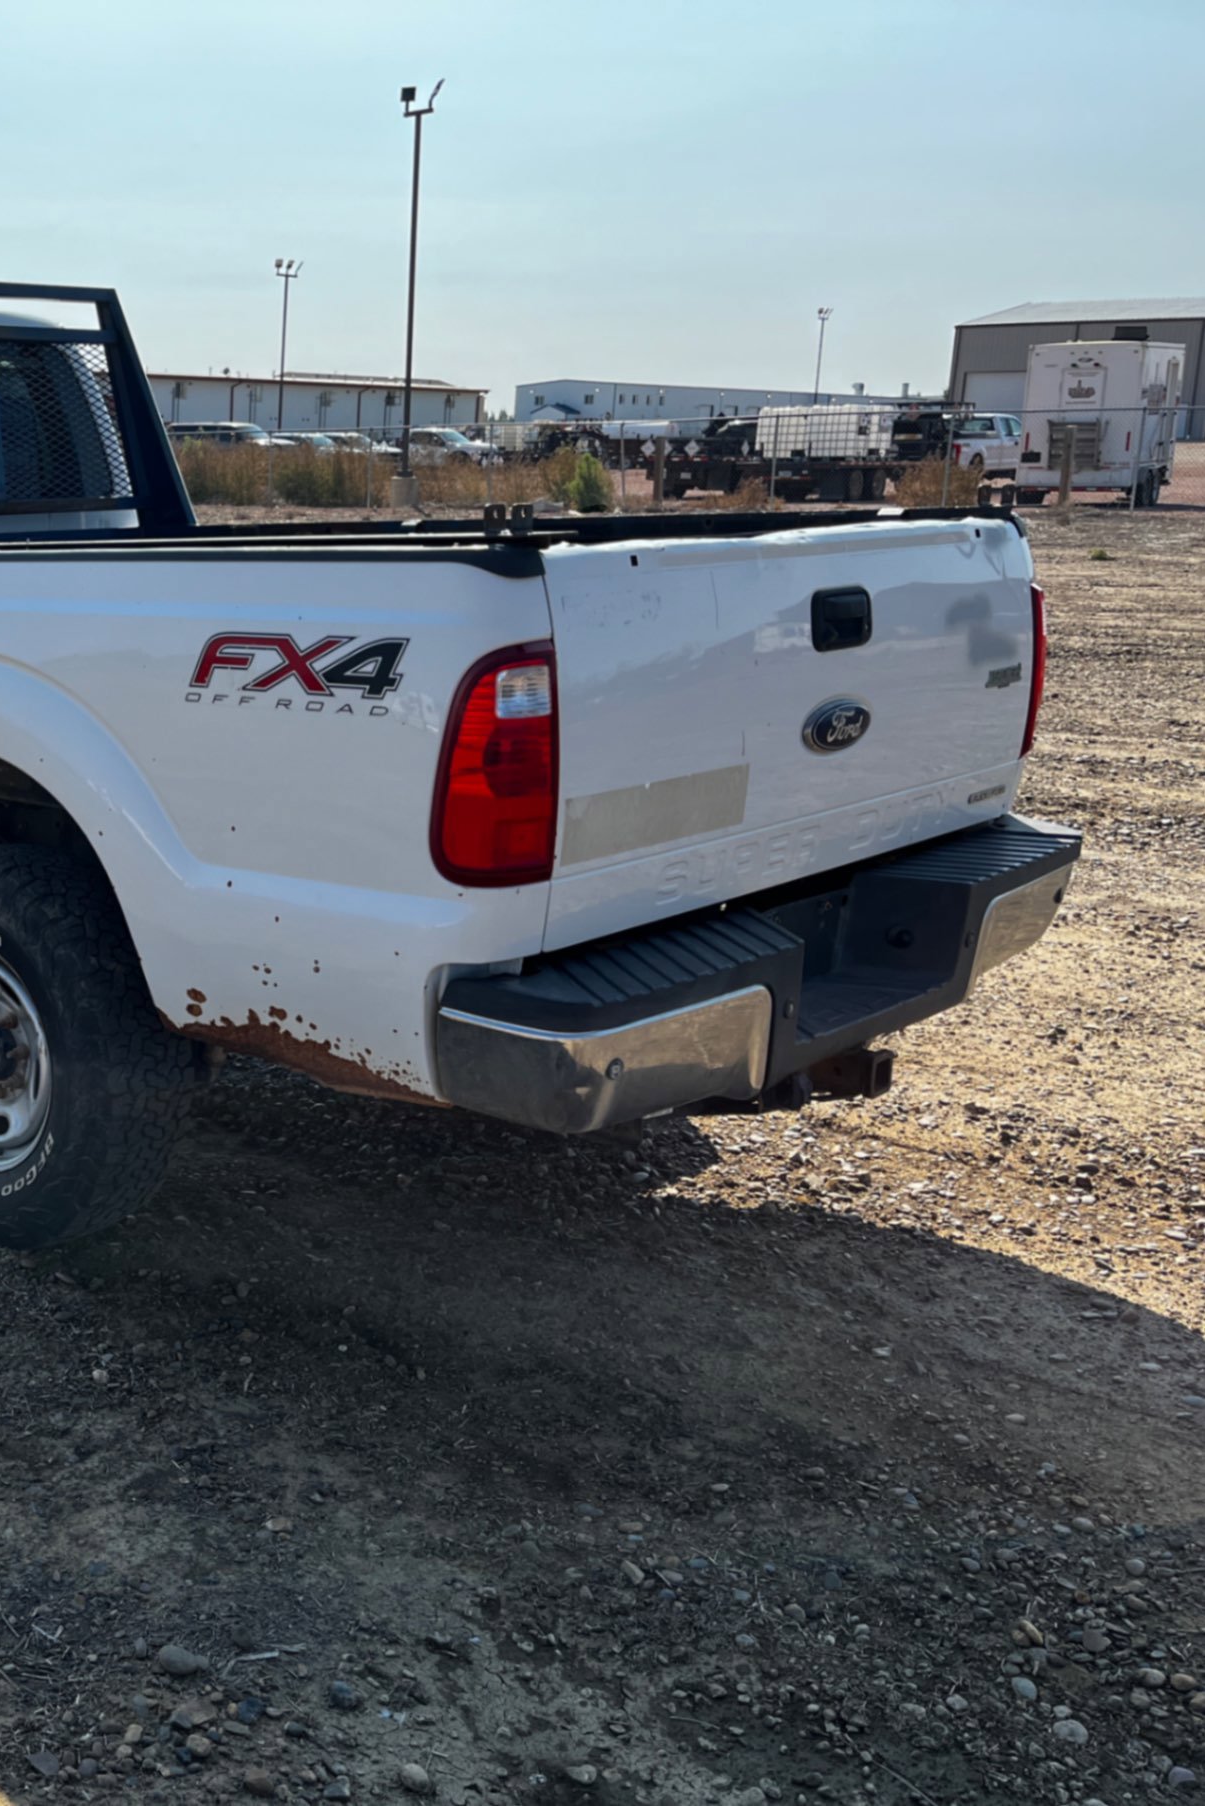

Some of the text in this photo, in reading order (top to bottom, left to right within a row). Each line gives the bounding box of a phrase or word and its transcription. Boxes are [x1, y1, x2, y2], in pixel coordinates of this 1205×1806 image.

[190, 632, 410, 699] FX4
[185, 692, 390, 717] OFF ROAD
[826, 709, 863, 743] Ford
[656, 824, 821, 906] SUPER
